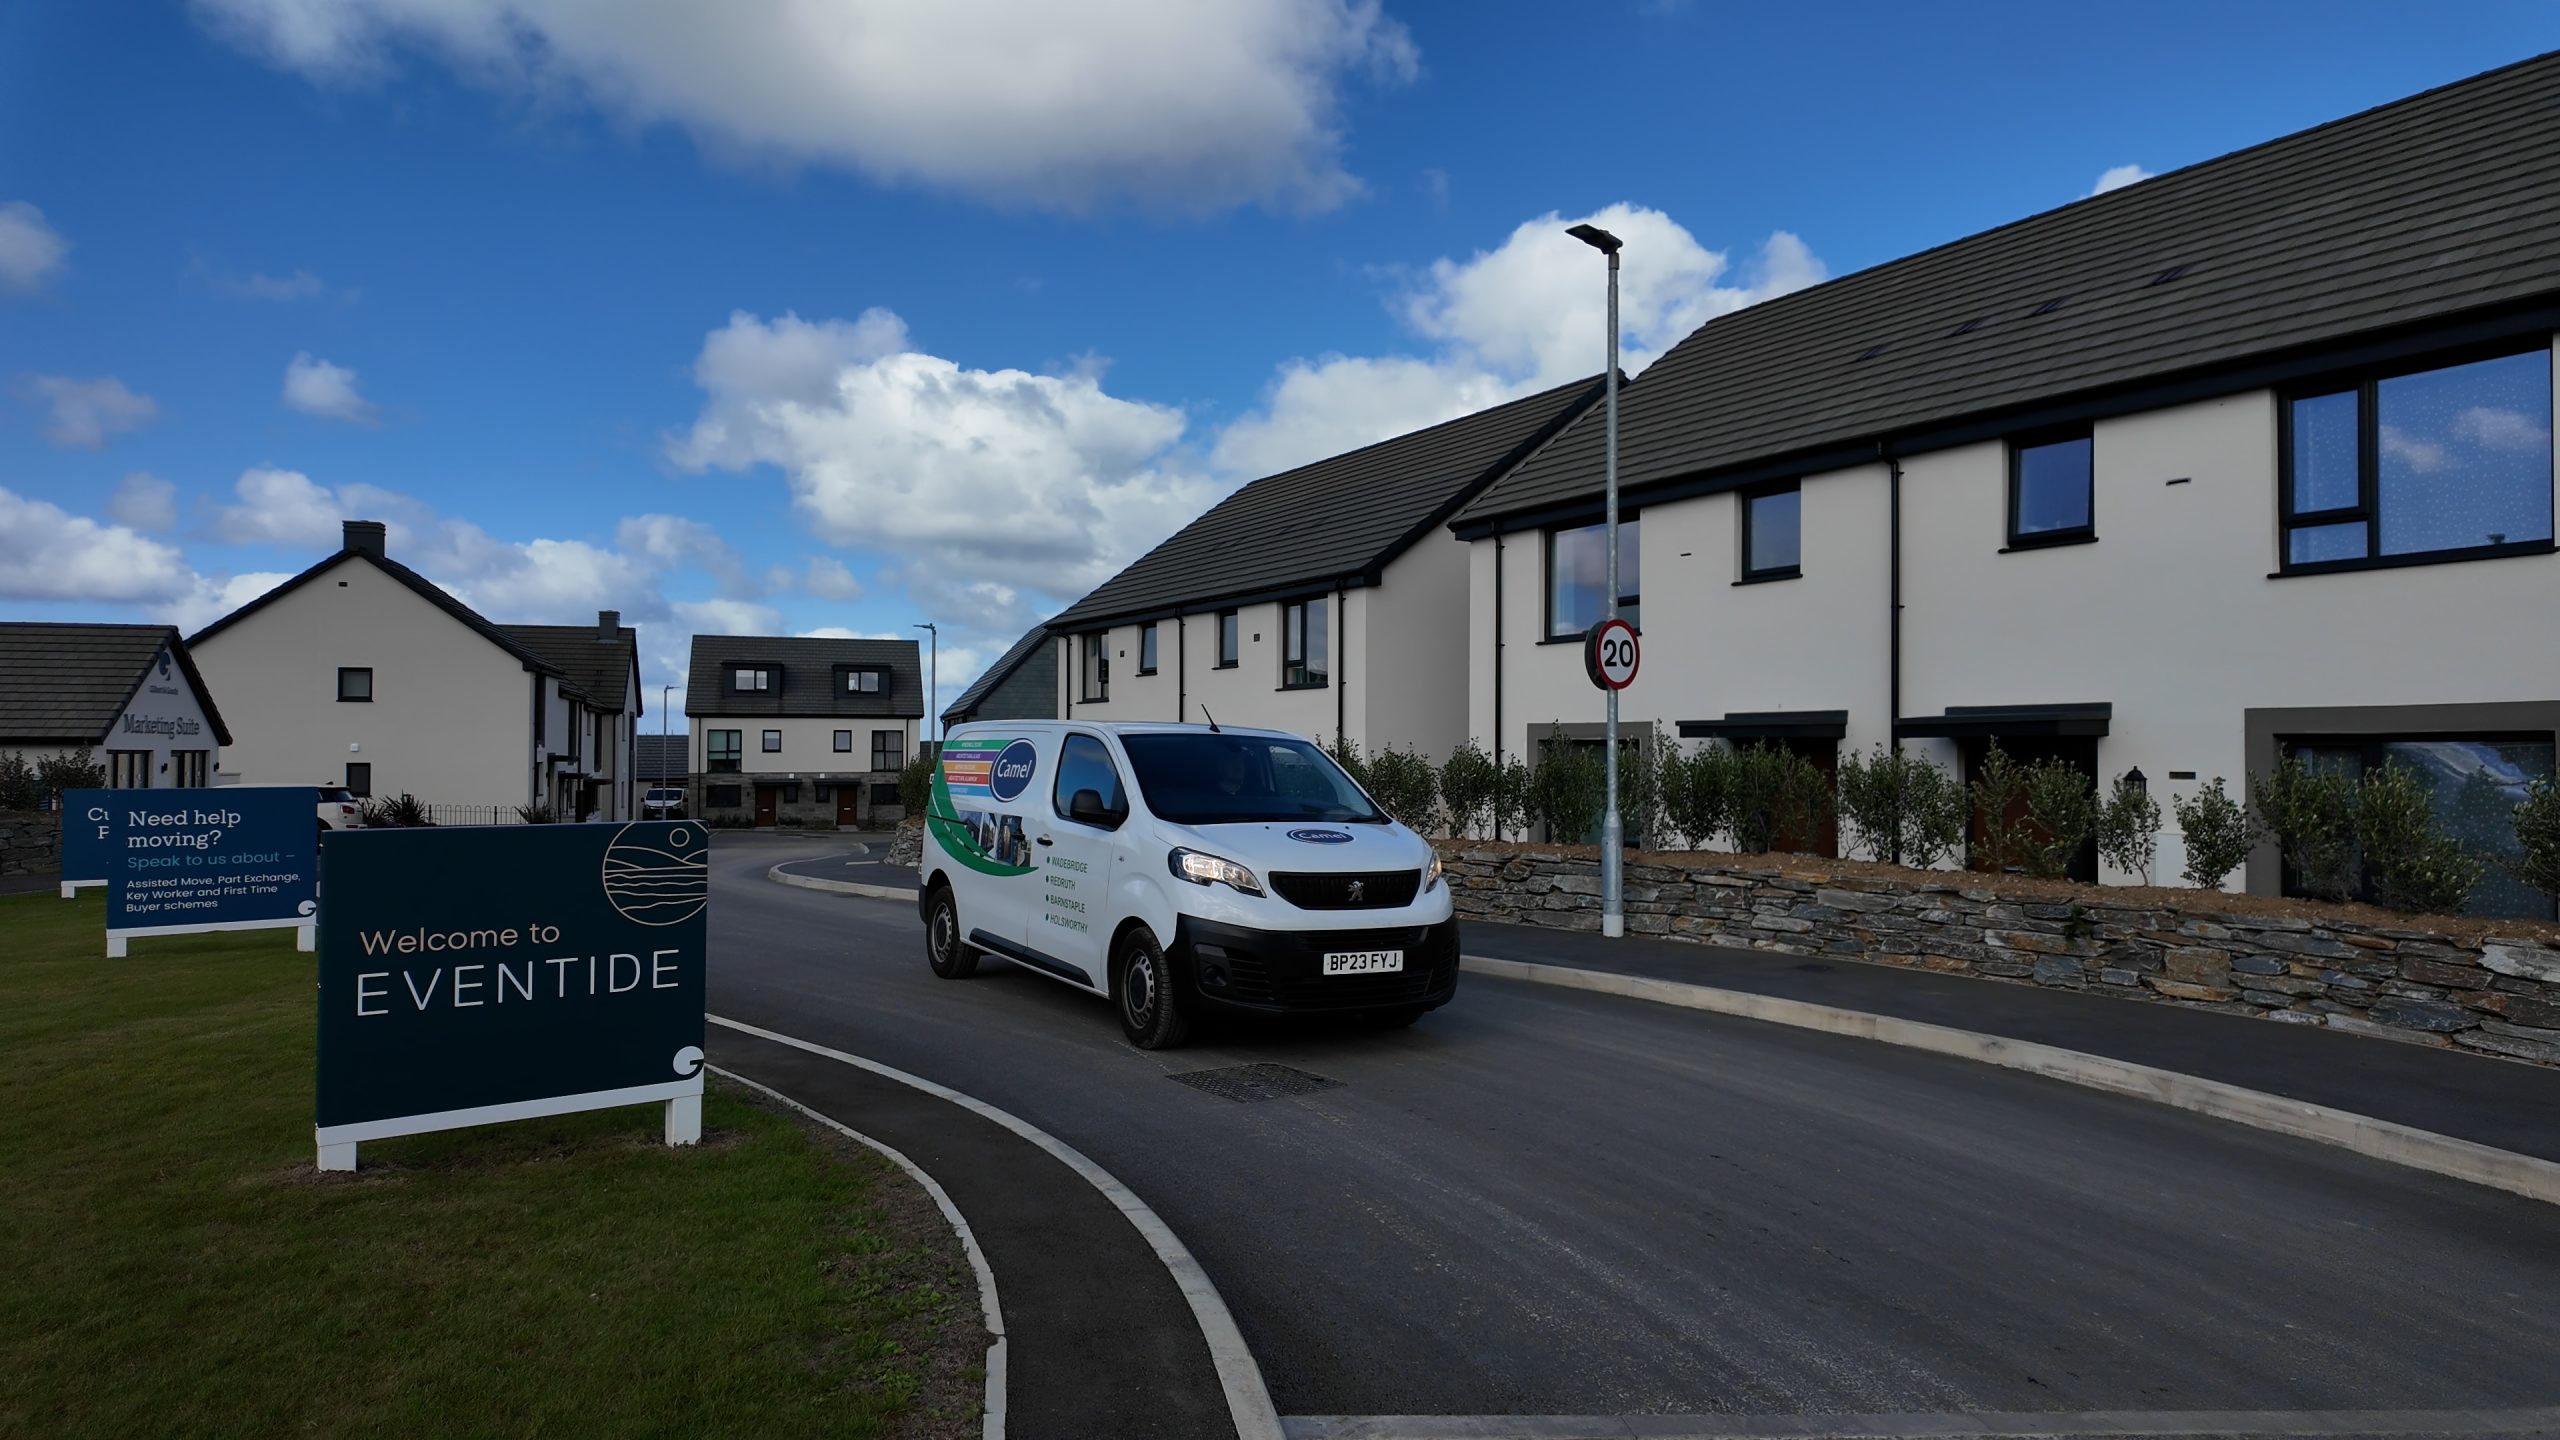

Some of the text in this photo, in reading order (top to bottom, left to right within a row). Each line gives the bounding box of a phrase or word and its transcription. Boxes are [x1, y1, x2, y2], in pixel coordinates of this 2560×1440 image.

[1603, 639, 1633, 667] 20
[123, 713, 200, 740] Marketing Suite
[997, 759, 1033, 778] Camel
[128, 809, 189, 827] Need
[193, 808, 242, 828] help
[127, 829, 222, 850] moving?
[1299, 832, 1348, 840] Camel
[127, 855, 180, 871] Speak
[186, 855, 202, 866] to
[207, 855, 227, 865] us
[231, 851, 280, 865] about
[1051, 856, 1088, 874] WADEBRIDGE
[126, 872, 301, 889] Assisted Move, Part Exchange,
[1050, 875, 1076, 890] REDRUTH
[126, 885, 278, 902] Key Worker and First Time
[126, 899, 218, 914] Buyer schemes
[1050, 894, 1086, 913] BARNSTAPLE
[1050, 913, 1088, 934] HOLSWORTHY
[359, 923, 561, 956] Welcome to
[1330, 952, 1398, 971] BP23 FYJ
[356, 949, 680, 1017] EVENTIDE
